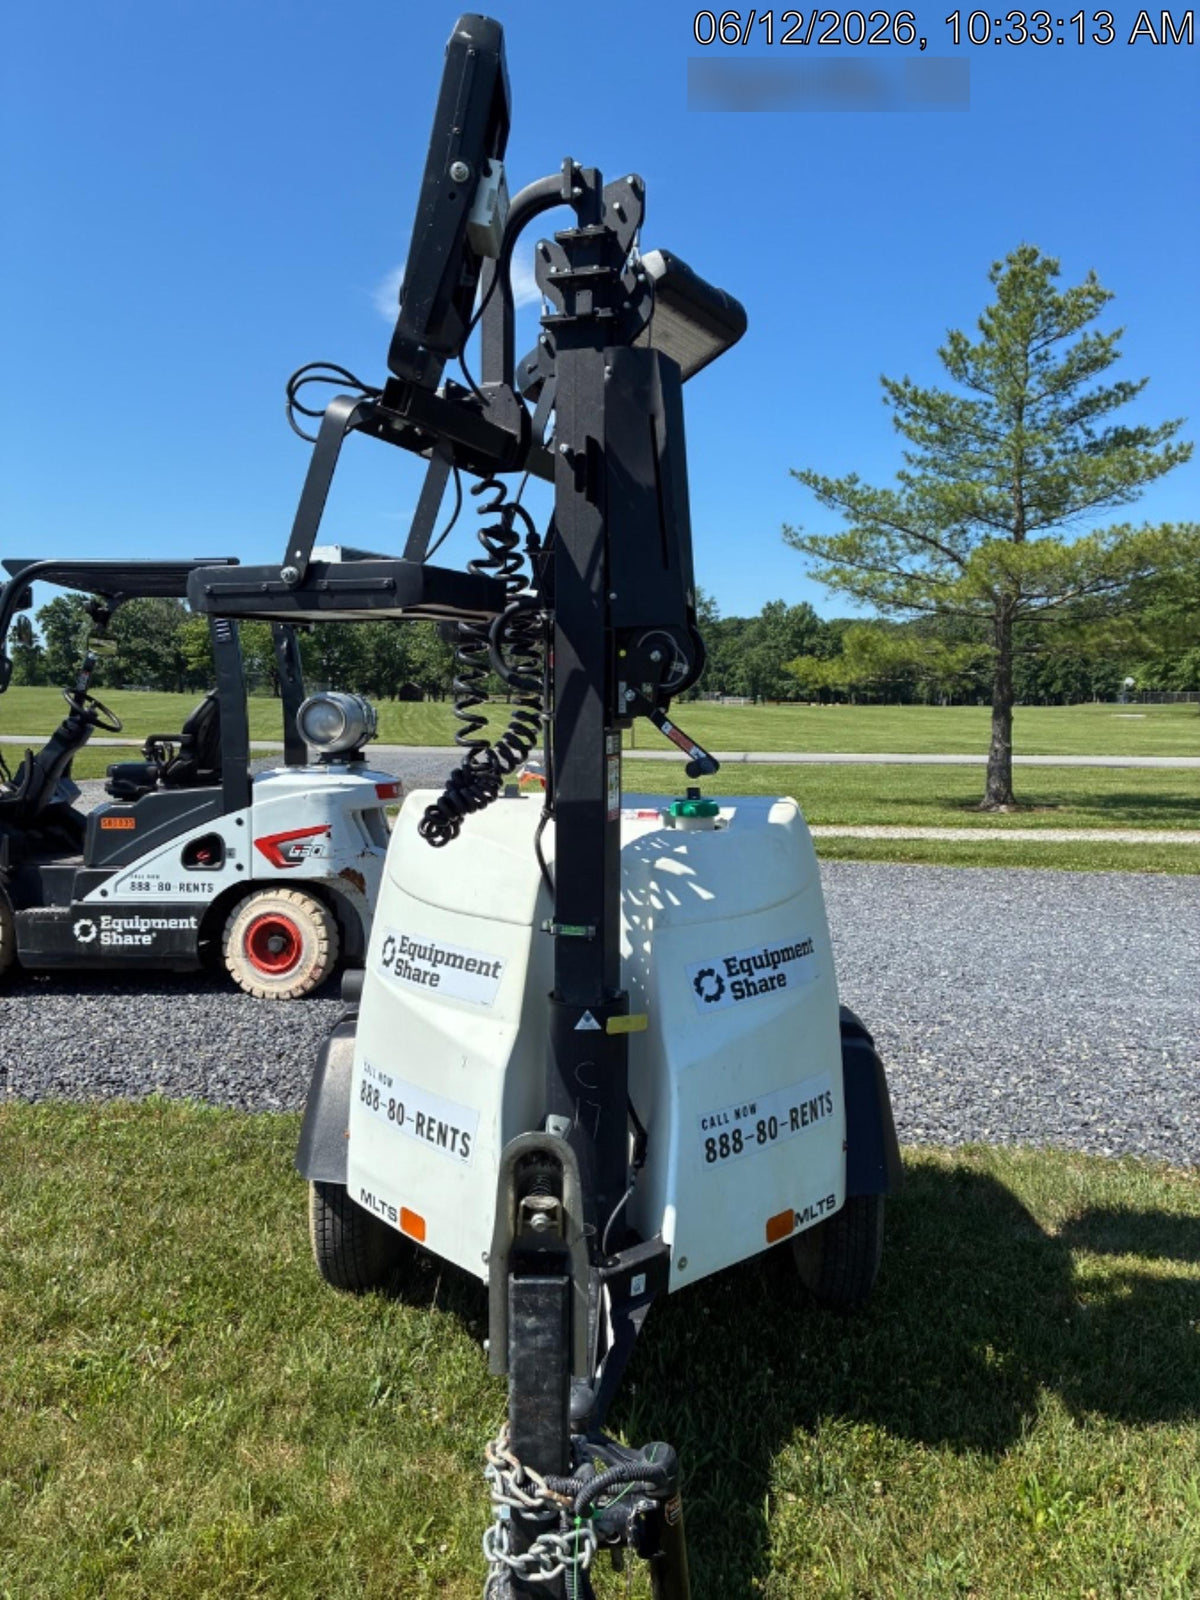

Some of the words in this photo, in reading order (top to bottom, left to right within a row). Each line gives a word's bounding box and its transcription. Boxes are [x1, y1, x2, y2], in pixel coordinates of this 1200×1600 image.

[100, 915, 198, 932] Equipment
[100, 931, 152, 945] Share
[393, 958, 441, 987] Share
[398, 934, 503, 979] Equipment
[722, 937, 815, 977] Equipment
[729, 970, 788, 1001] Share
[360, 1079, 472, 1158] 888-80-RENTS
[701, 1113, 730, 1131] CALL
[734, 1103, 757, 1121] NOW
[704, 1090, 834, 1164] 888-80-RENTS
[360, 1187, 398, 1223] MLTS
[793, 1194, 837, 1228] MLTS
